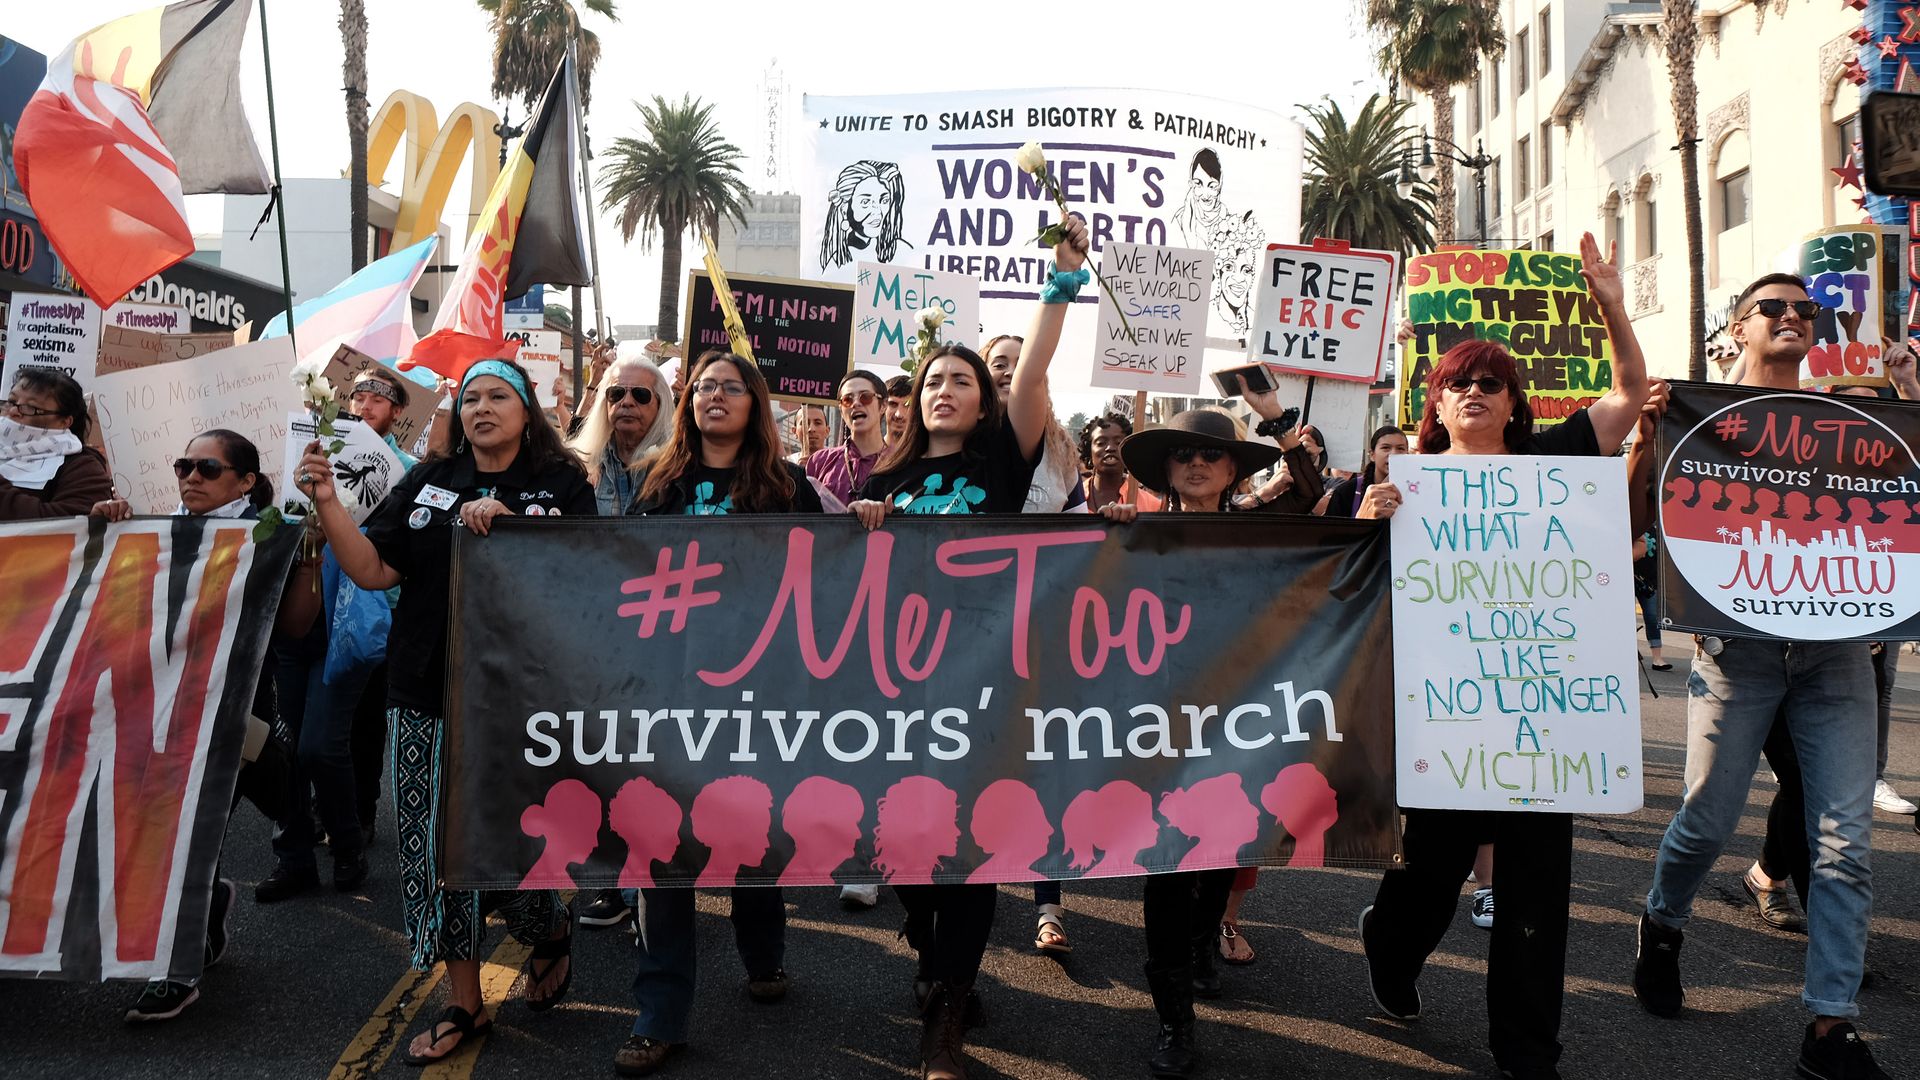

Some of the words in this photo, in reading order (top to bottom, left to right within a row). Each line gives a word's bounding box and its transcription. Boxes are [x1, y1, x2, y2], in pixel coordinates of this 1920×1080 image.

[835, 115, 893, 132] UNITE
[902, 114, 928, 132] TO
[938, 109, 1014, 132] SMASH
[1027, 107, 1116, 129] BIGOTRY
[1128, 109, 1145, 130] &
[1154, 112, 1256, 151] PATRIARCHY
[937, 158, 1165, 208] WOMEN'S
[927, 208, 1013, 247] AND
[1114, 246, 1147, 274] WE
[1155, 250, 1202, 280] MAKE
[1407, 252, 1508, 287] STOP
[1105, 275, 1135, 294] THE
[1139, 279, 1201, 301] WORLD
[1272, 257, 1374, 306] FREE
[21, 300, 86, 325] #TimesUp!
[127, 273, 246, 331] cDonald's
[1124, 298, 1182, 321] SAFER
[1279, 297, 1366, 330] ERIC
[1472, 287, 1549, 322] THE
[16, 320, 26, 331] for
[27, 322, 87, 339] capitalism,
[116, 309, 178, 333] #TimesUp!
[755, 315, 763, 323] IS
[775, 318, 790, 327] THE
[1107, 322, 1159, 344] WHEN
[1163, 328, 1192, 347] WE
[22, 335, 66, 352] sexism
[66, 342, 76, 354] &
[33, 352, 60, 363] white
[175, 338, 196, 360] 5
[777, 336, 831, 358] NOTION
[1103, 348, 1157, 370] SPEAK
[1165, 353, 1186, 372] UP
[1262, 330, 1341, 362] LYLE
[758, 357, 777, 367] THAT
[126, 383, 155, 415] NO
[780, 377, 831, 396] PEOPLE
[1421, 464, 1519, 509] THIS
[1536, 463, 1570, 507] IS
[1681, 459, 1818, 487] survivors'
[1825, 473, 1920, 494] march
[1421, 512, 1531, 551] WHAT
[1543, 515, 1575, 552] A
[1406, 555, 1593, 604] SURVIVOR
[1718, 549, 1896, 597] MMIW
[1466, 607, 1577, 640] LOOKS
[1732, 596, 1895, 618] survivors
[1477, 642, 1561, 678] LIKE
[1425, 678, 1482, 717] NO
[1494, 675, 1627, 714] LONGER
[523, 687, 995, 767] survivors'
[1023, 681, 1344, 762] march
[1515, 716, 1541, 752] A
